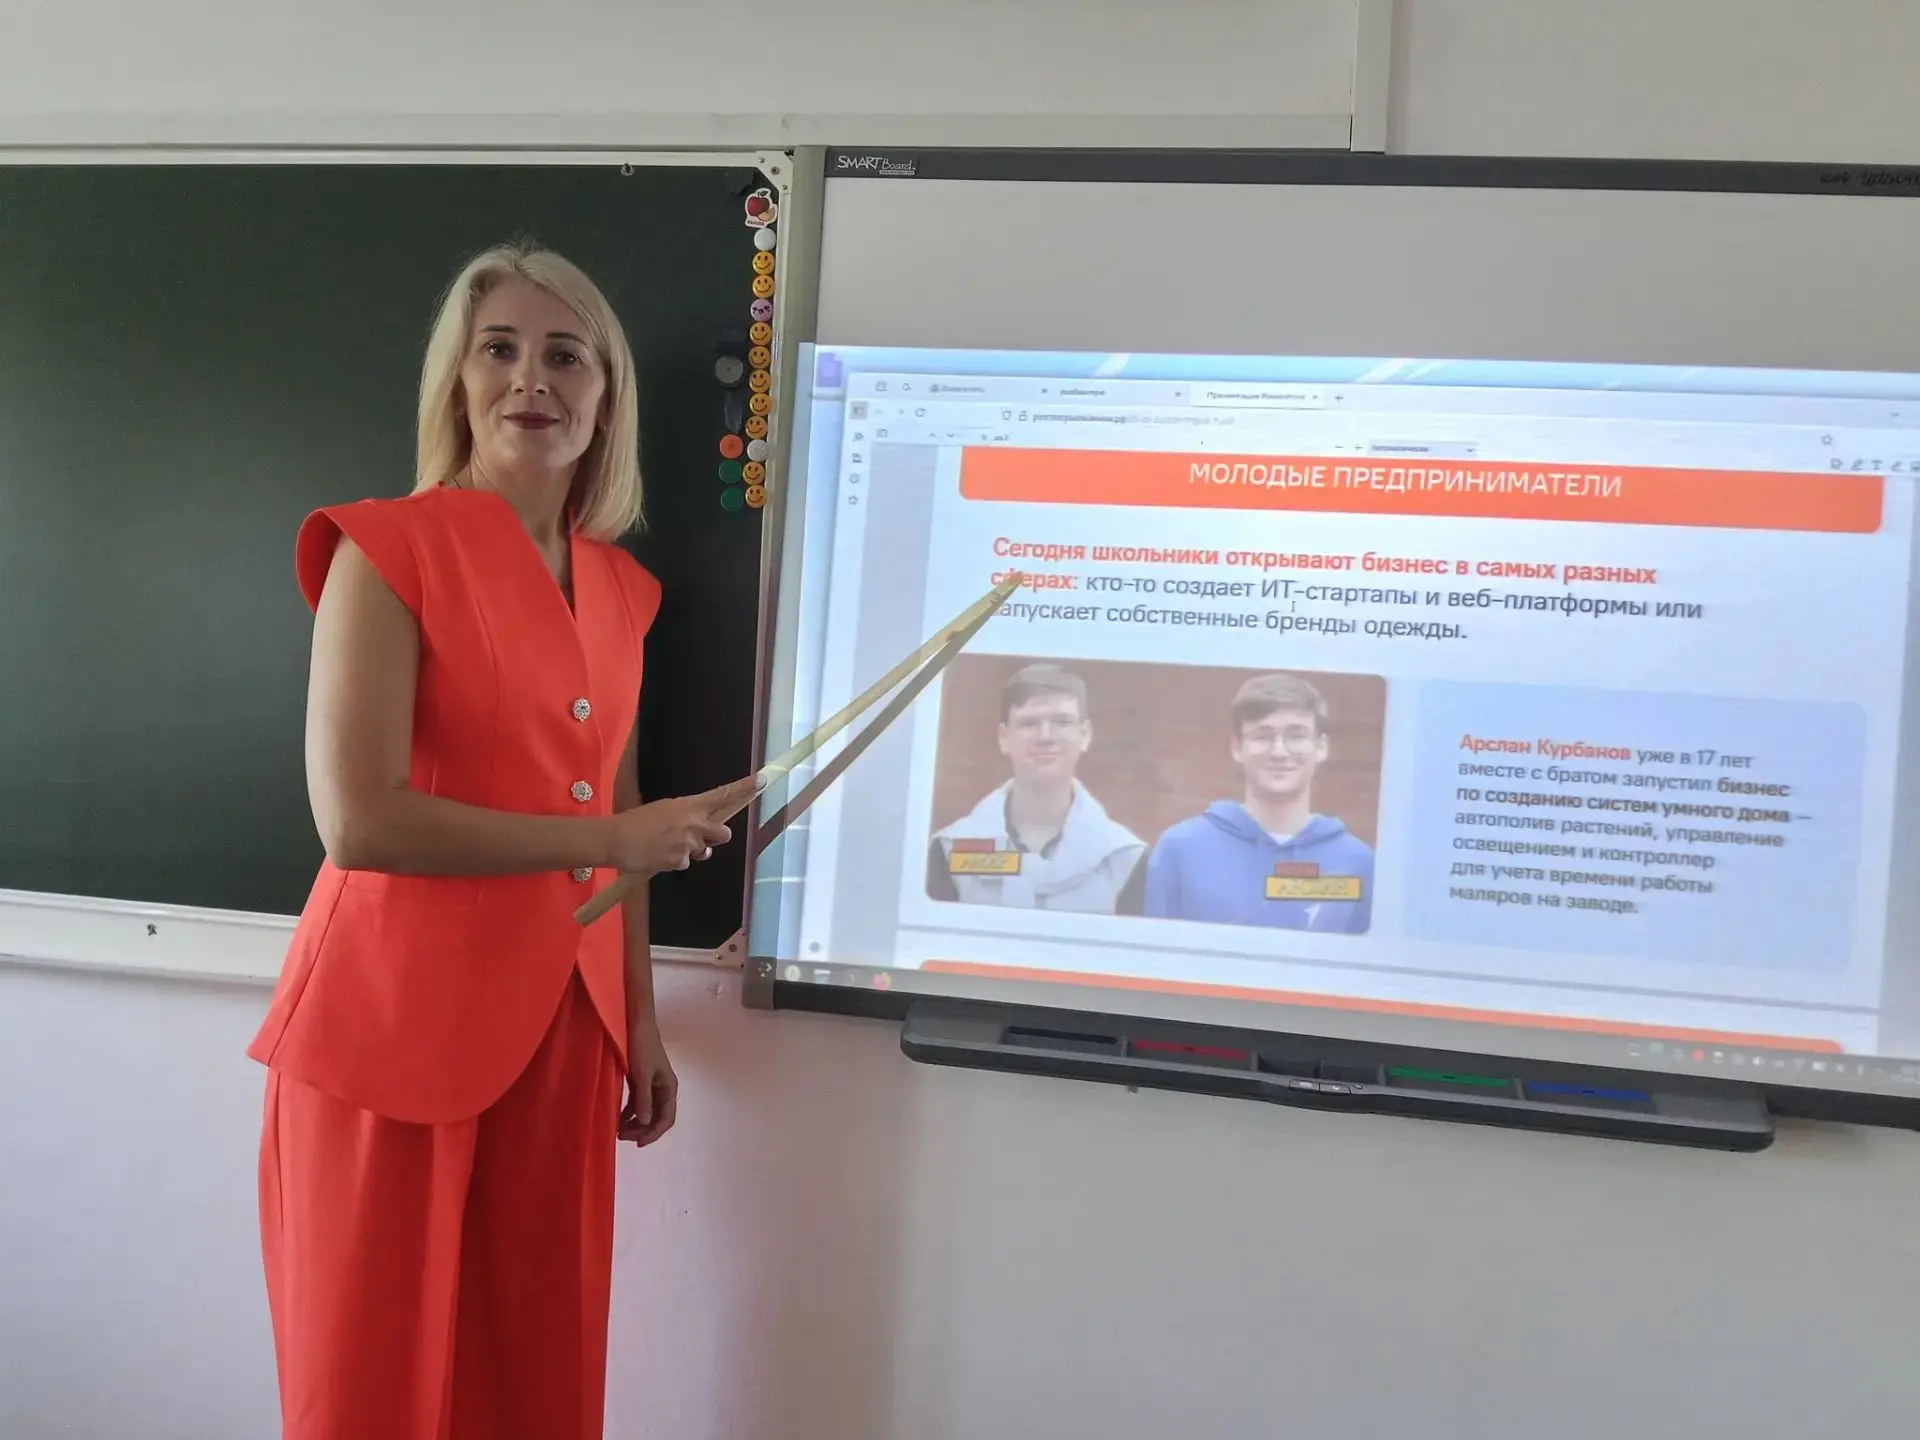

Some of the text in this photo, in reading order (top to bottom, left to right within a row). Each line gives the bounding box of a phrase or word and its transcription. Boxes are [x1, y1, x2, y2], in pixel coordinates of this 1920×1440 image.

[837, 155, 913, 170] SMART Board
[1189, 463, 1622, 498] МОЛОДЫЕ ПРЕДПРИНИМАТЕЛИ
[992, 537, 1657, 585] Сегодня школьники открывают бизнес в самых разных
[991, 568, 1078, 593] серах:
[1163, 578, 1255, 598] создает
[1425, 591, 1439, 606] и
[1655, 601, 1702, 619] или
[994, 602, 1468, 640] апускает собственные бренды одежды.
[1460, 733, 1754, 770] Арслан Курбанов уже в 17 лет
[1458, 762, 1792, 797] вместе с братом запустил бизнес
[1456, 787, 1480, 802] по
[1485, 789, 1582, 810] созданию
[1587, 795, 1657, 814] систем
[1662, 801, 1733, 820] умного
[1738, 806, 1790, 824] дома
[1455, 811, 1785, 848] автополив растений, управление
[1452, 836, 1715, 869] освещением и контроллер
[1450, 861, 1713, 893] для учета времени работы
[1449, 885, 1639, 914] маляров на заводе.
